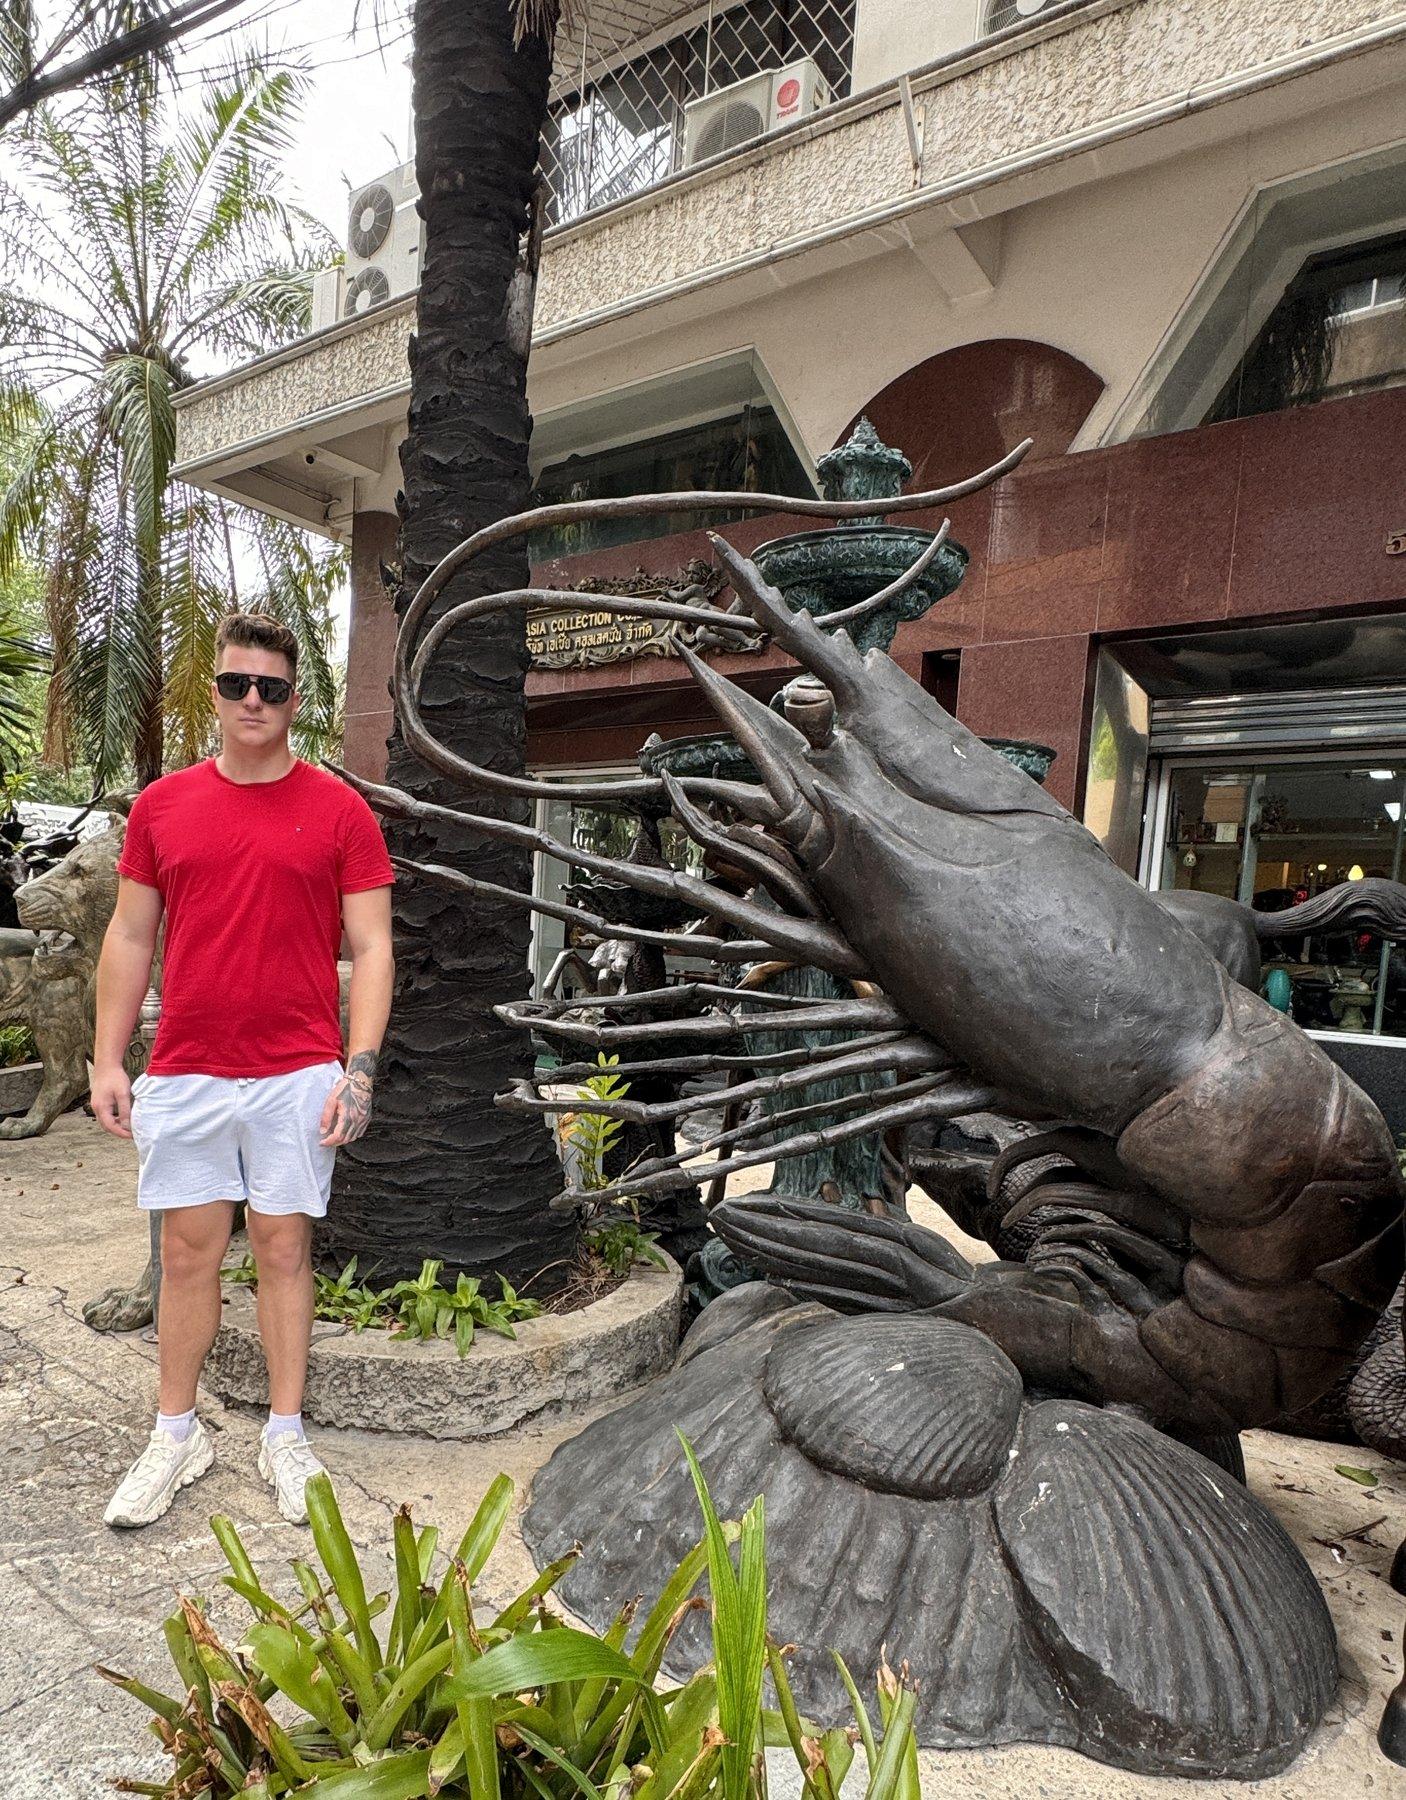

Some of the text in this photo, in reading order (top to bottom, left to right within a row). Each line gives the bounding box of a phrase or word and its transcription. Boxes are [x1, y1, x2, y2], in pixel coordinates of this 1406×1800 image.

[526, 621, 547, 637] ASIA
[550, 611, 612, 633] COLLECTION
[626, 622, 653, 641] จำกัด
